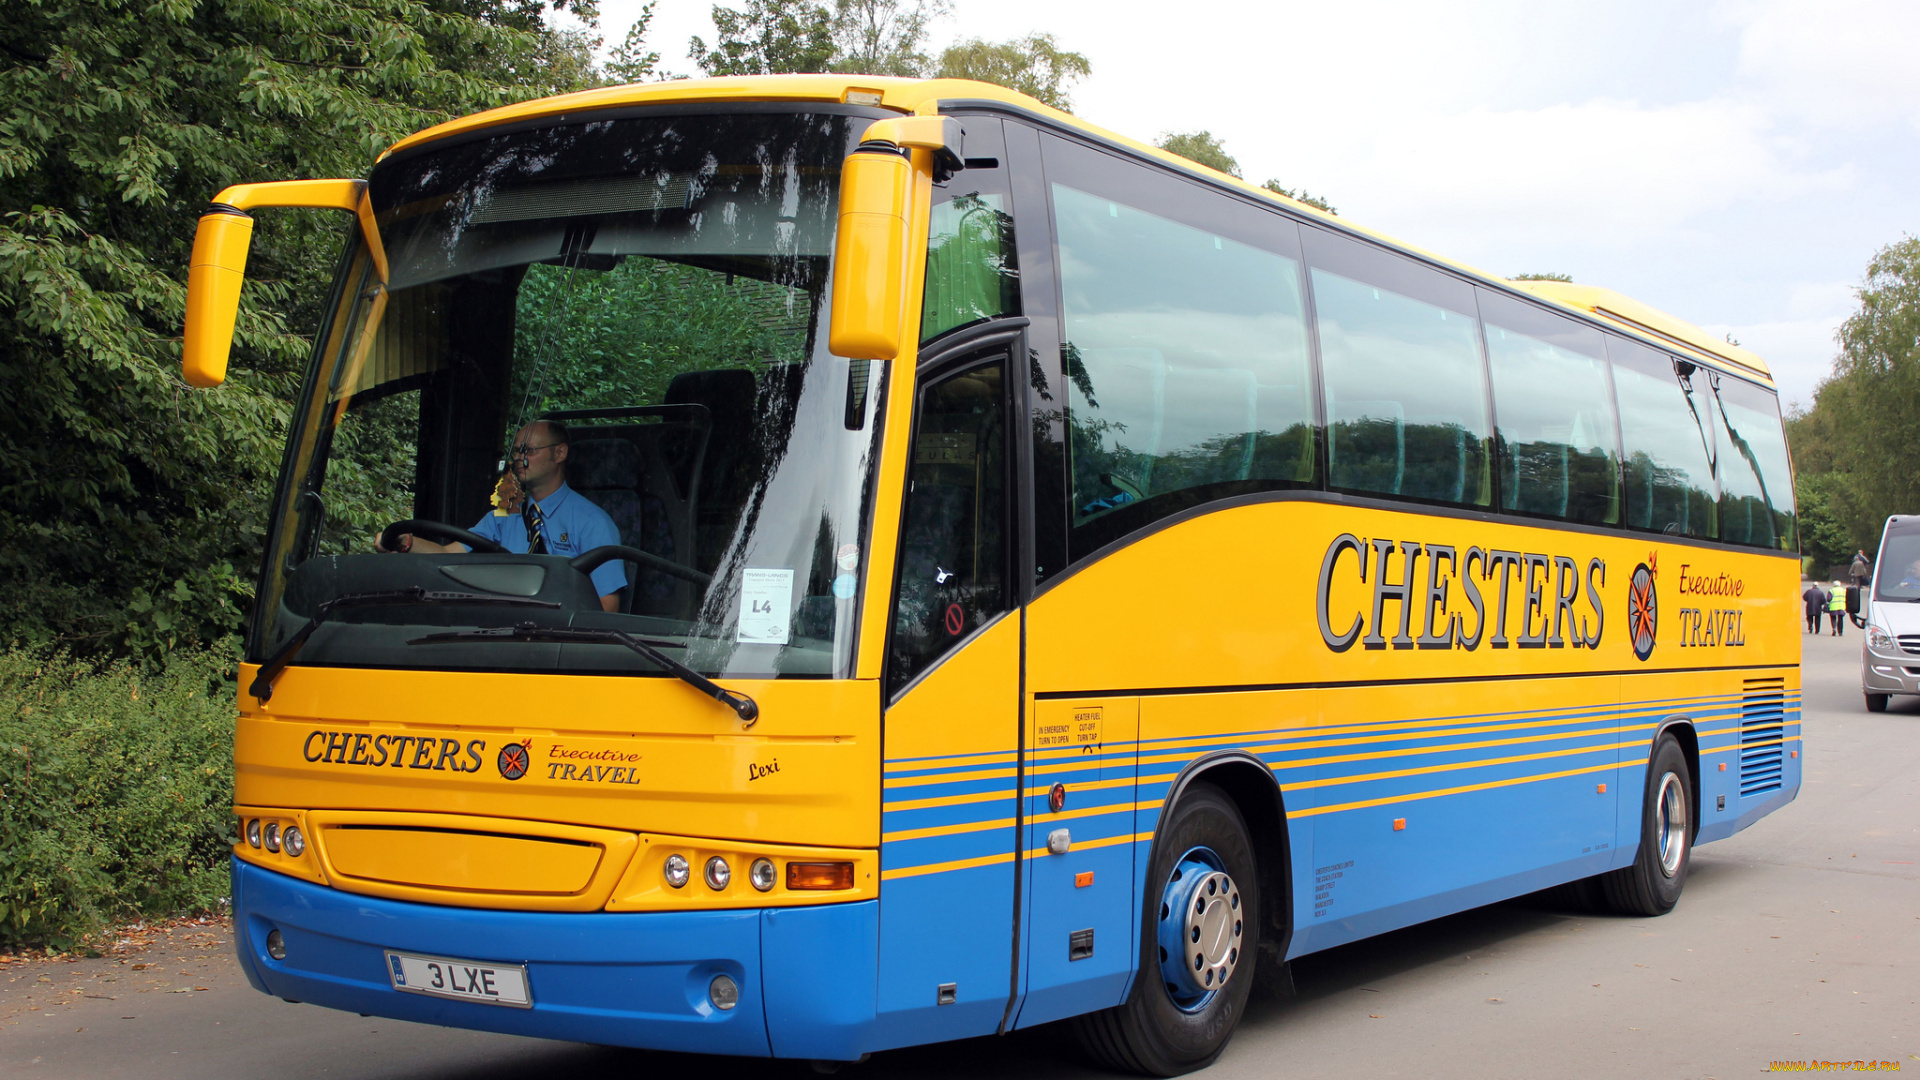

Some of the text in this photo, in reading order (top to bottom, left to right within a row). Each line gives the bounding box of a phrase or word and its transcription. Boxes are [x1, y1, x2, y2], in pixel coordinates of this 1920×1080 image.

[916, 451, 975, 460] EULAS
[1679, 564, 1745, 597] Executive
[1316, 533, 1605, 653] CHESTERS
[752, 600, 772, 614] L4
[1679, 608, 1745, 647] TRAVEL
[1074, 712, 1101, 721] HEATER FUEL
[1044, 725, 1070, 734] EMERGENCY
[1077, 732, 1098, 742] TURN TAP
[1038, 735, 1069, 745] TURN TO OPEN
[303, 730, 486, 774] CHESTERS
[549, 744, 642, 762] Executive
[547, 762, 641, 784] TRAVEL
[749, 758, 780, 781] Lexi
[428, 963, 499, 996] 3 LXE
